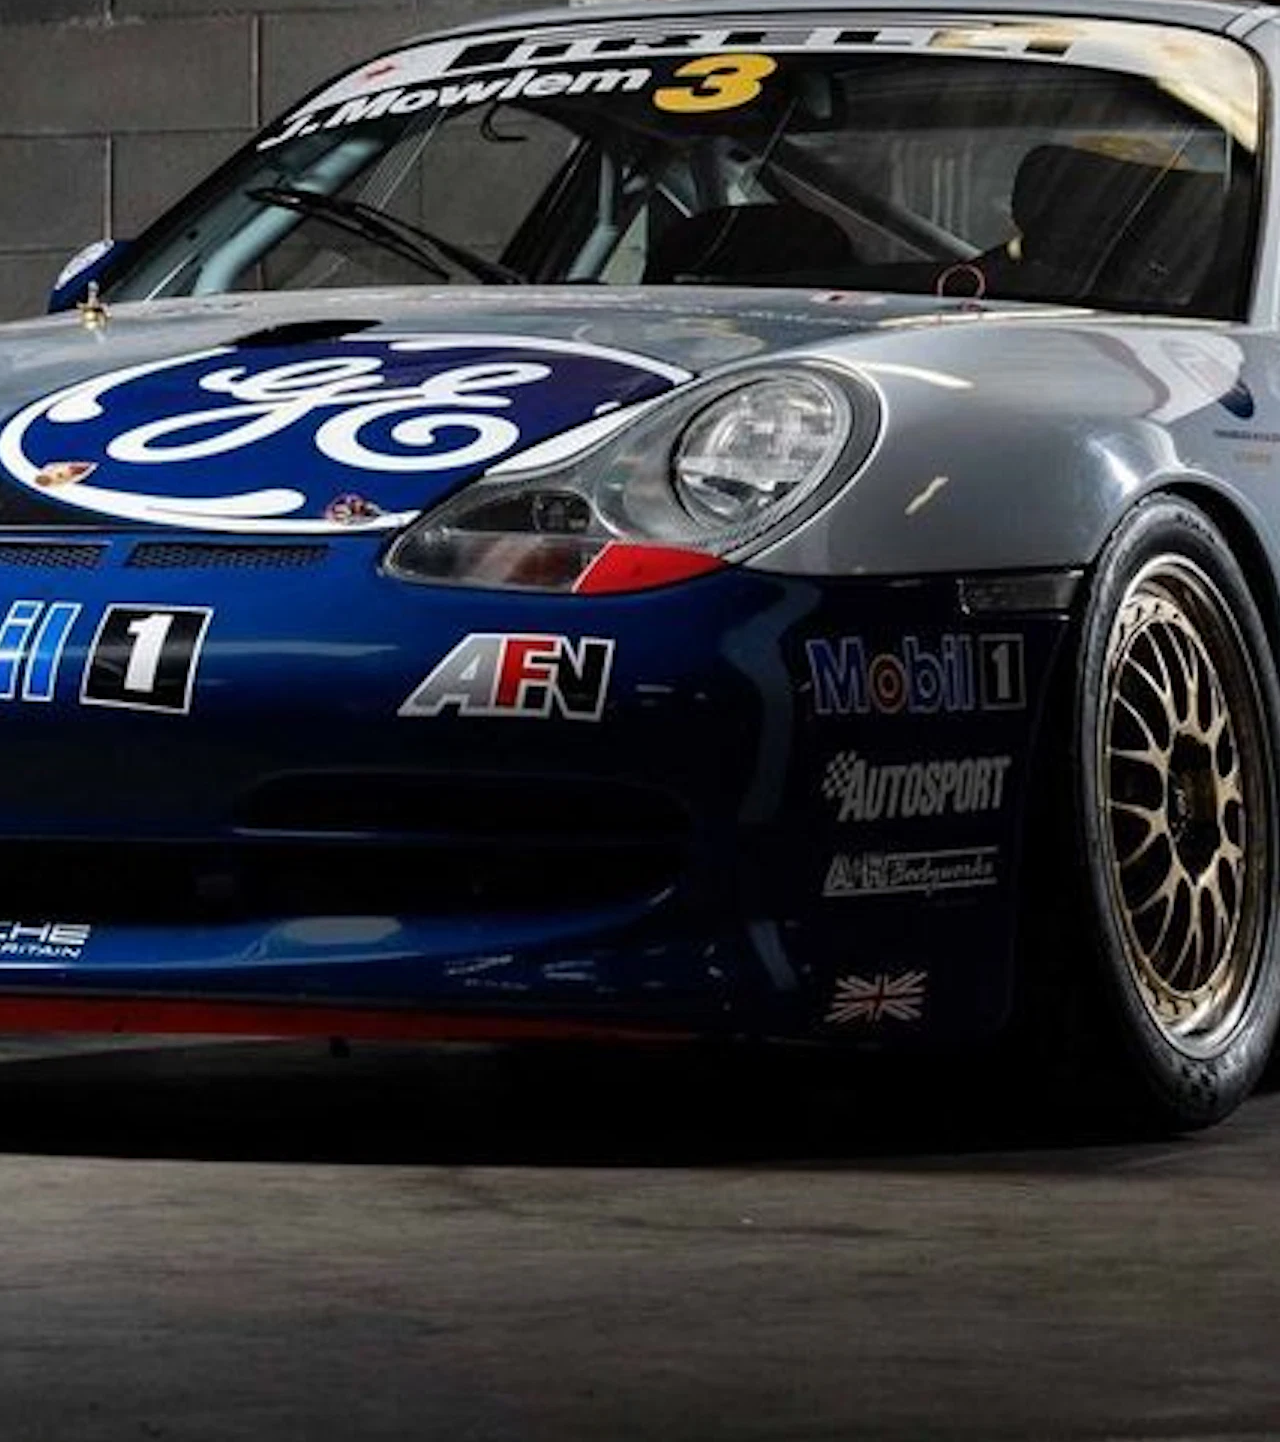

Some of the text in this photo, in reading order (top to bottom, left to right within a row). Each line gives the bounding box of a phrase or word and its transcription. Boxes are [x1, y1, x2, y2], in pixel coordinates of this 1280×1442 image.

[653, 52, 777, 114] 3
[125, 612, 173, 694] 1
[397, 632, 615, 722] AFN
[804, 633, 977, 716] Mobil
[835, 754, 1014, 822] AUTOSPORT
